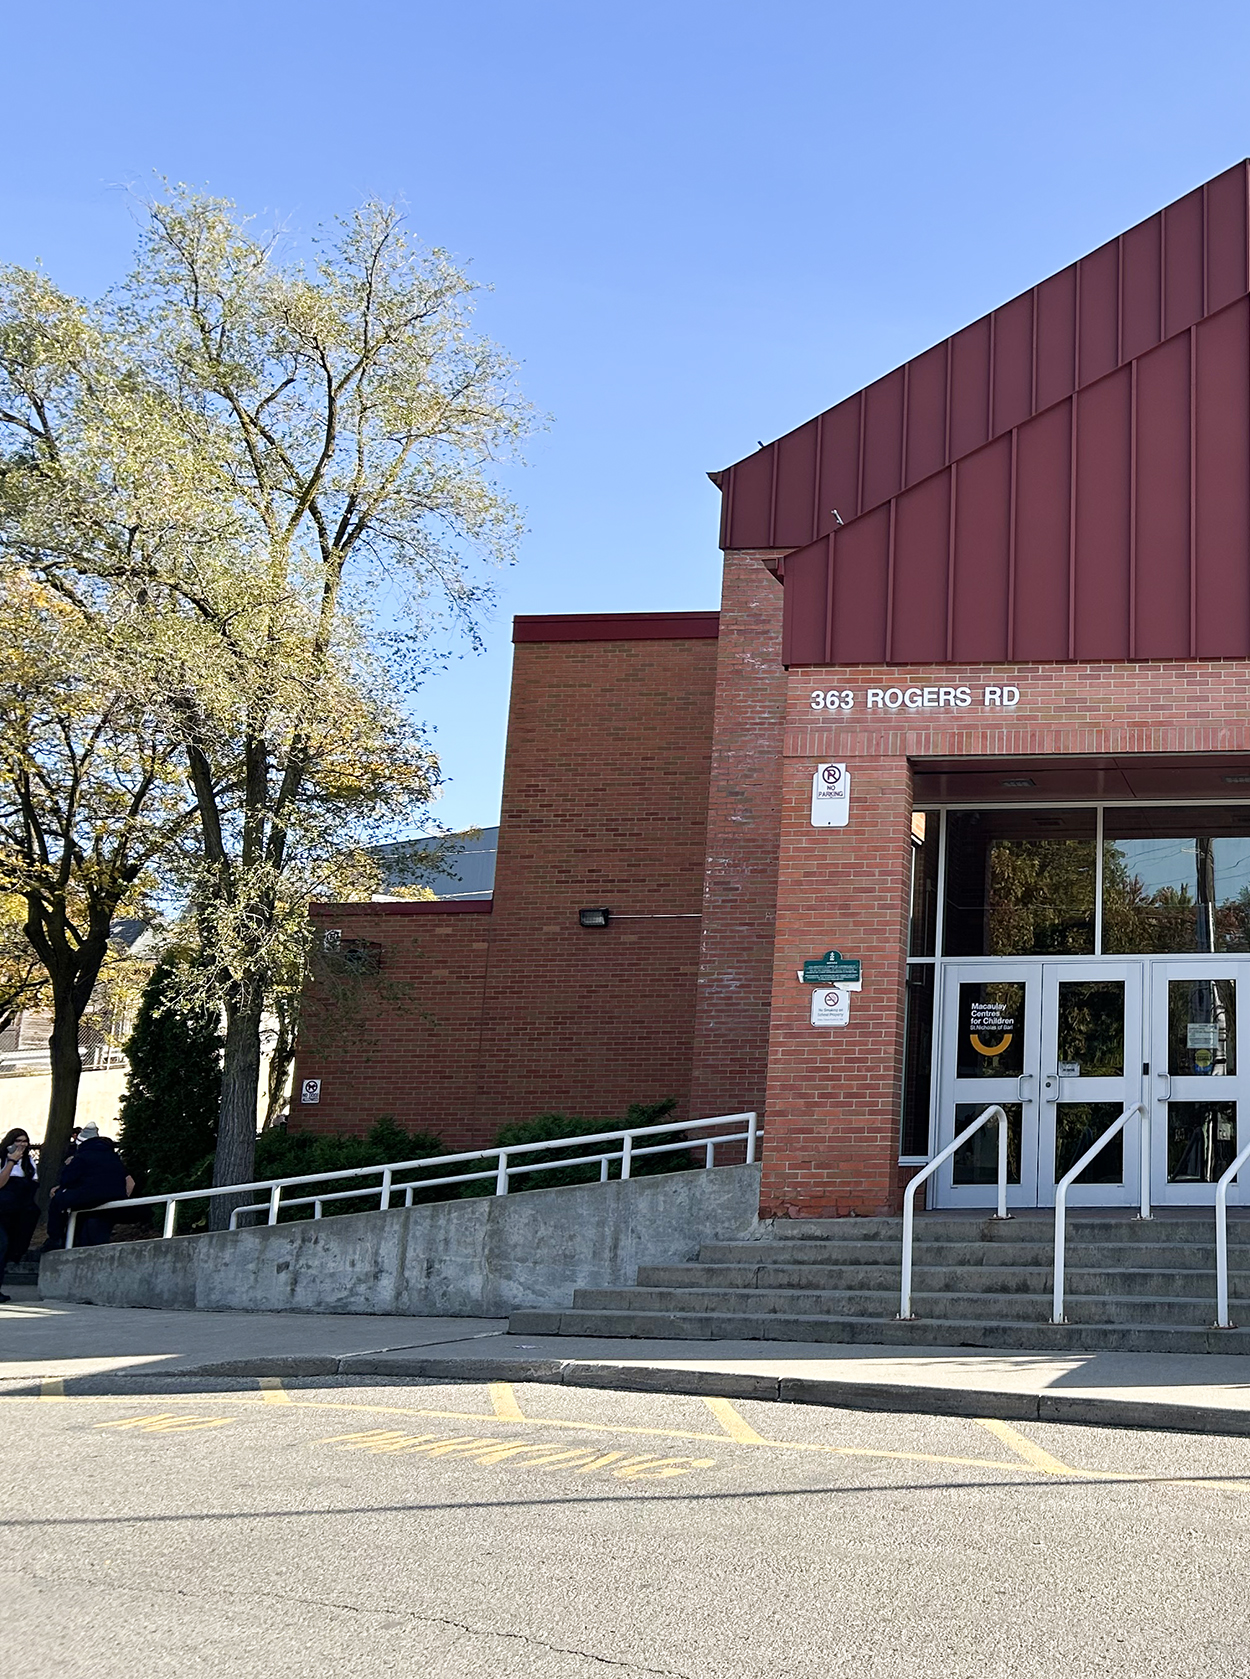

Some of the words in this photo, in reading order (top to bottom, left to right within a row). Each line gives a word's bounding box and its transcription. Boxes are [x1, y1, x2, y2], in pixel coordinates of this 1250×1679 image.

[810, 690, 854, 710] 363
[866, 686, 972, 709] ROGERS
[984, 686, 1020, 707] RD
[971, 1003, 1006, 1011] Macaulay
[971, 1010, 1000, 1018] Centres
[92, 1412, 239, 1432] NO
